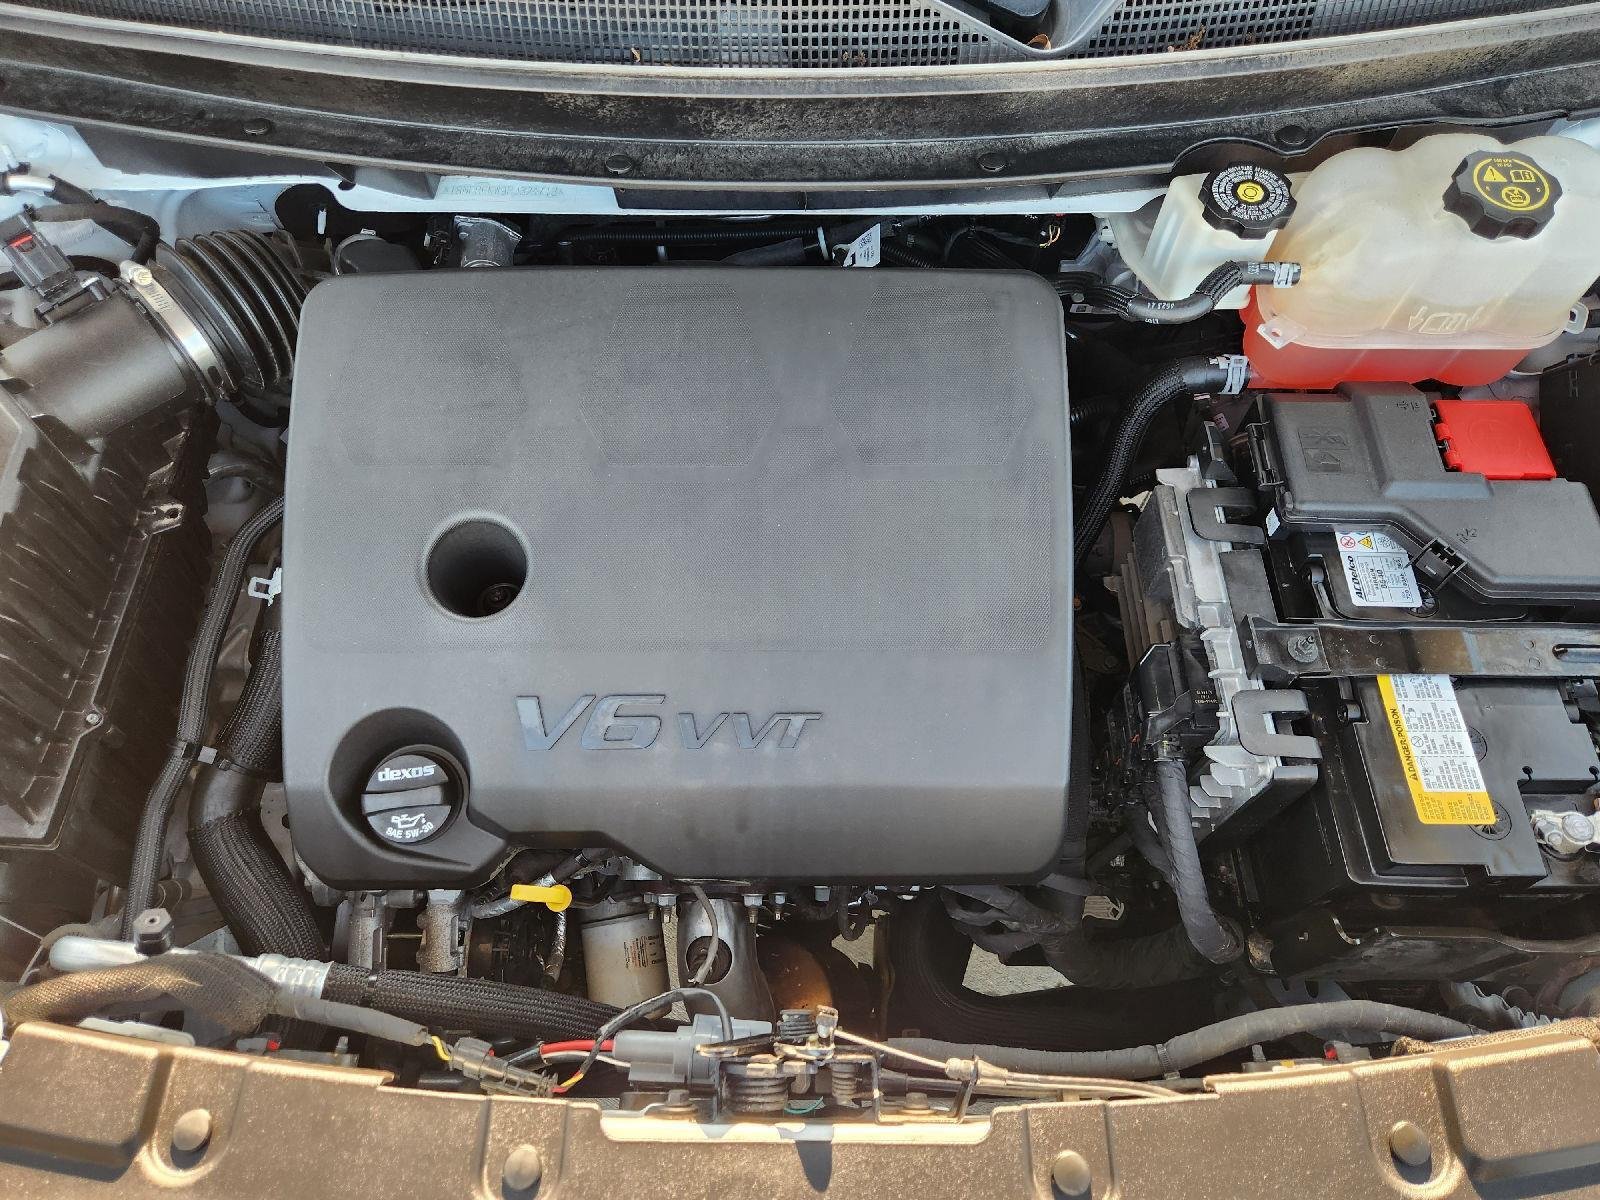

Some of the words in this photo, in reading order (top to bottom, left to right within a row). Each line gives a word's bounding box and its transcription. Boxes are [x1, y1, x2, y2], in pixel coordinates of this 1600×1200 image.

[1347, 555, 1364, 601] ACDelco
[515, 694, 667, 751] V6
[678, 711, 823, 749] VVT
[377, 764, 437, 782] dexos
[385, 828, 403, 839] SAE
[405, 821, 434, 838] 5W-30
